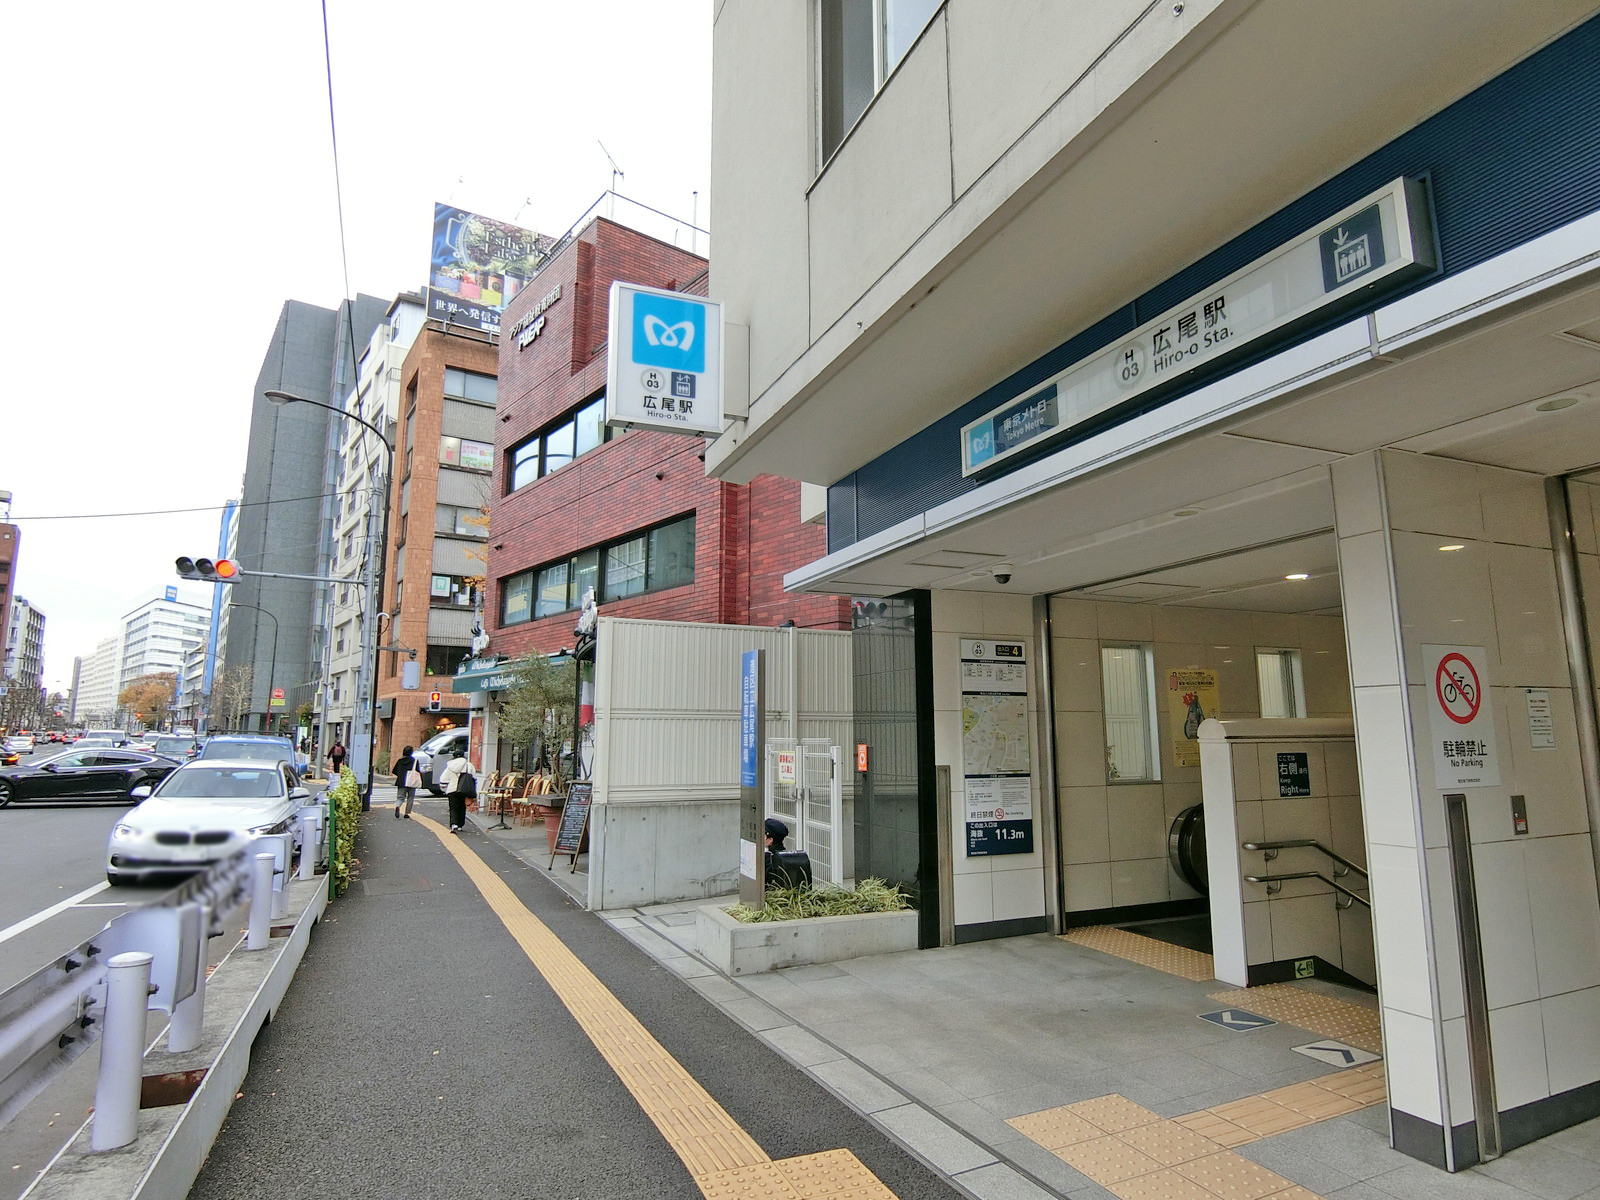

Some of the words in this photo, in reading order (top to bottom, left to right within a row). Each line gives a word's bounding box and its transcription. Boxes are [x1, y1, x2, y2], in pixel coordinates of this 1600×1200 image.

[485, 231, 524, 251] Esthe
[484, 242, 517, 261] Labo
[1152, 295, 1227, 357] 広尾駅
[1125, 349, 1134, 364] H
[1153, 342, 1199, 373] Hiro-o
[1203, 327, 1234, 349] Sta.
[650, 372, 657, 380] H
[1121, 362, 1139, 381] 03
[646, 379, 660, 389] 03
[642, 394, 693, 414] 広尾駅
[647, 410, 672, 420] Hiro-o
[674, 413, 689, 421] Sta.
[1003, 399, 1047, 433] 東京メトロ
[1006, 427, 1025, 441] Tokyo
[1024, 417, 1045, 433] Metro
[1012, 646, 1019, 656] 4
[1443, 740, 1488, 758] 駐輪禁止
[1451, 759, 1460, 767] No
[1461, 758, 1484, 769] Parking
[1281, 785, 1299, 796] Right
[995, 828, 1025, 840] 11.3m
